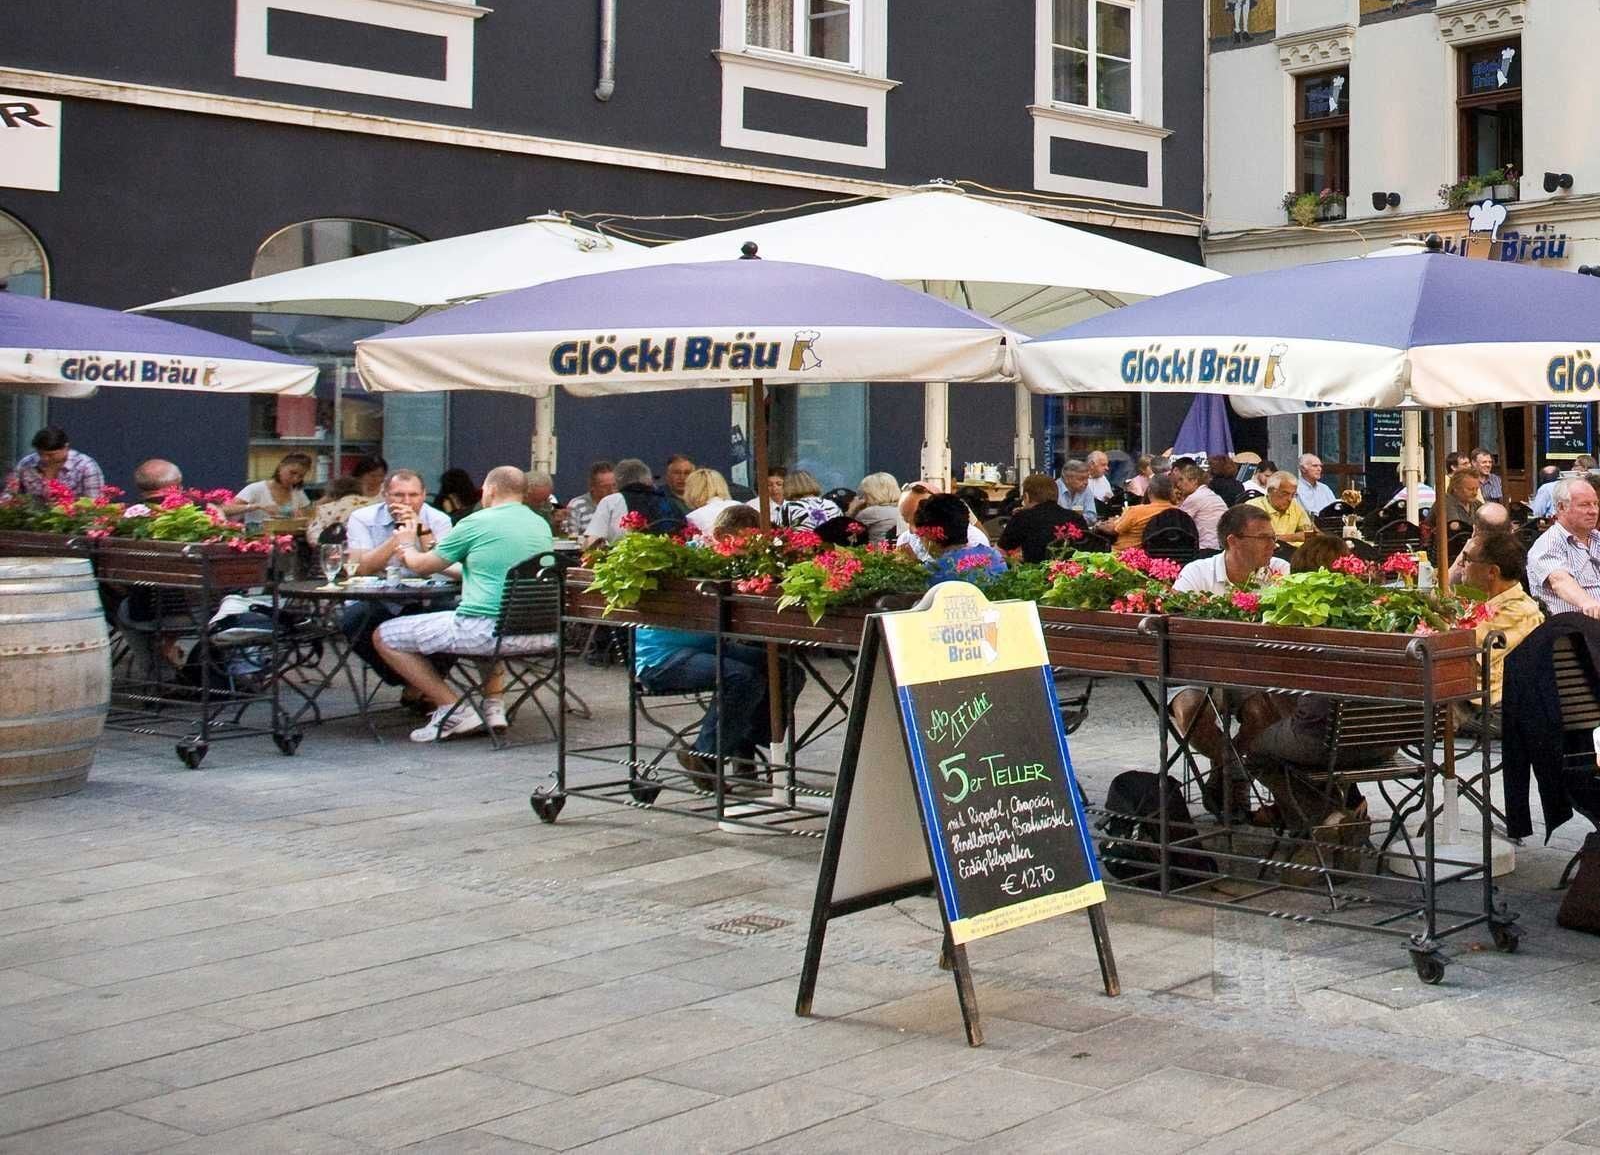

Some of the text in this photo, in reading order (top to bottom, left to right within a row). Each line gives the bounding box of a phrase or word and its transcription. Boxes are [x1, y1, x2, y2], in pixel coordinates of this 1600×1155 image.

[1501, 224, 1566, 262] Bräu
[61, 356, 198, 385] Glöckl Bräu
[551, 331, 781, 376] Glöckl Bräu
[1121, 344, 1260, 386] Glöckl Bräu
[942, 624, 983, 644] Glöckl
[949, 642, 982, 662] Bräu
[938, 753, 1051, 803] 5er TELLER
